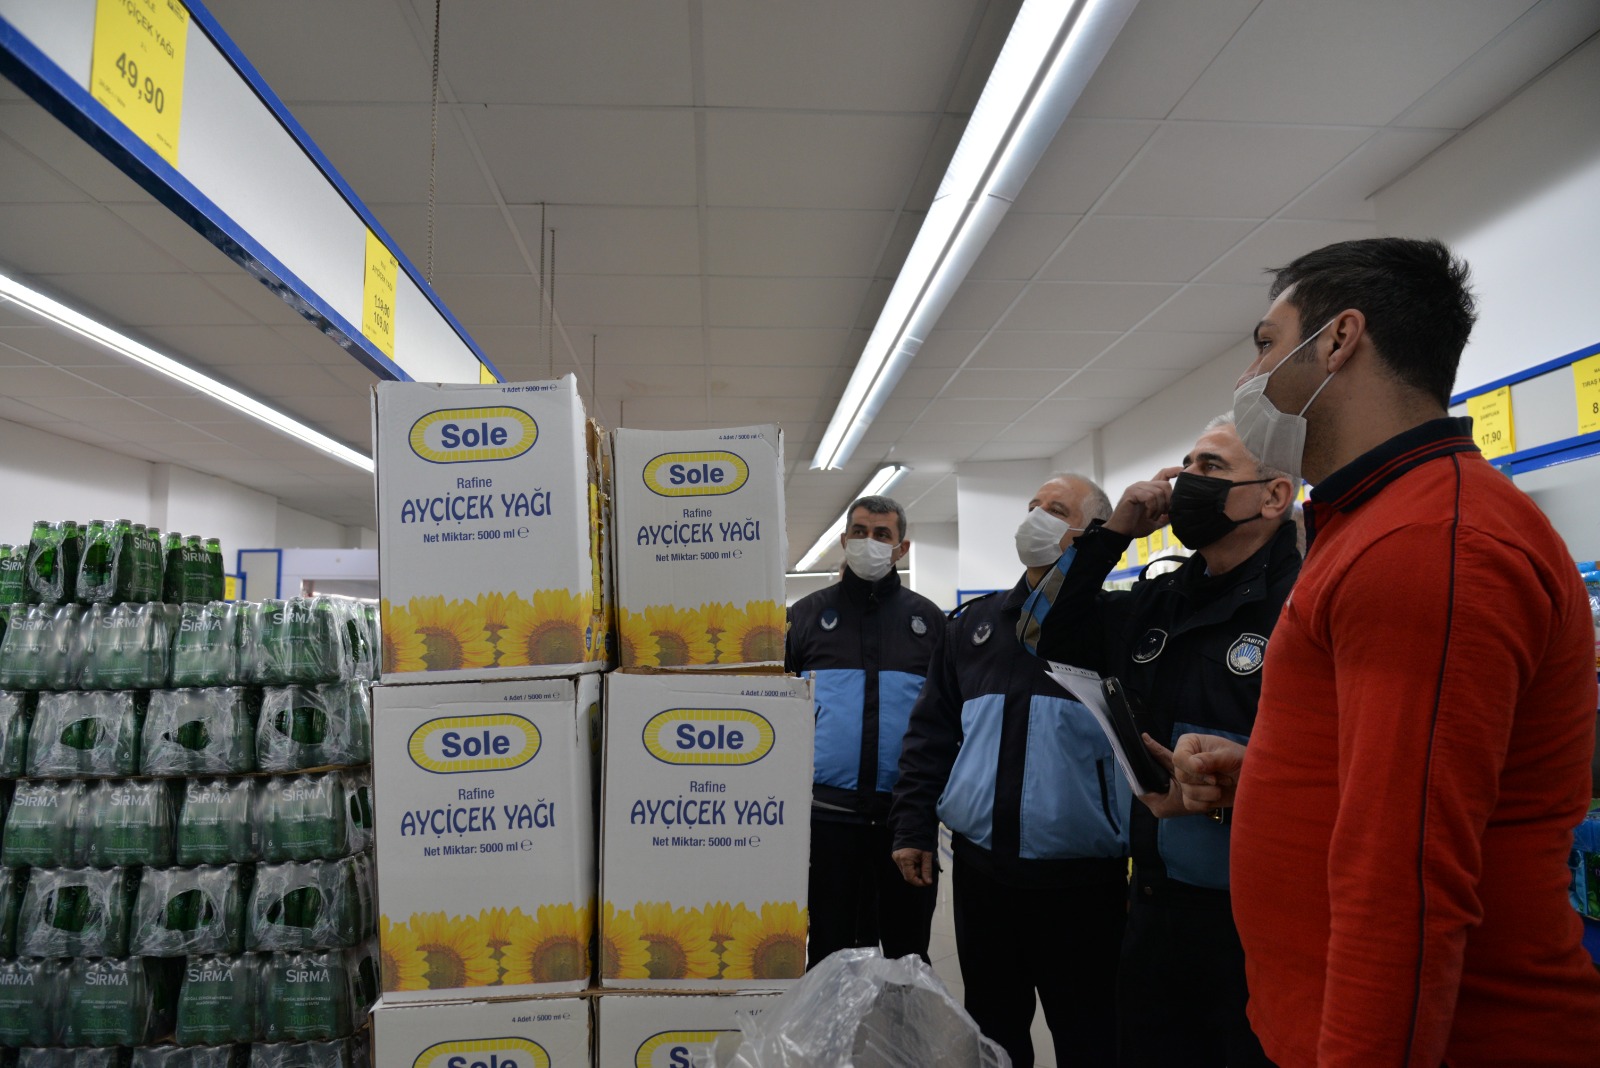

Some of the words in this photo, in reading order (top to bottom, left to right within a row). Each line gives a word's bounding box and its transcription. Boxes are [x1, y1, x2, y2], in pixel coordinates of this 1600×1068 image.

[116, 52, 164, 114] 49,90
[441, 423, 508, 448] Sole
[1482, 430, 1501, 445] 17,90
[669, 464, 724, 484] Sole
[457, 477, 492, 489] Rafine
[401, 492, 494, 526] AYÇİÇEK
[502, 487, 552, 517] YAĞI
[683, 508, 712, 518] Rafine
[424, 533, 440, 543] Net
[441, 531, 474, 542] Miktar:
[478, 530, 500, 540] 5000
[503, 529, 515, 538] ml
[637, 521, 713, 548] AYÇİÇEK
[720, 518, 760, 541] YAĞI
[134, 537, 157, 553] SIRMA
[182, 549, 211, 564] SIRMA
[656, 553, 669, 562] Net
[671, 552, 698, 561] Miktar:
[700, 552, 719, 560] 5000
[722, 551, 731, 559] ml
[1, 560, 25, 571] SIRM
[12, 618, 54, 631] SIRMA
[102, 615, 145, 629] SIRMA
[181, 619, 222, 632] SIRMA
[676, 724, 744, 749] Sole
[441, 730, 510, 758] Sole
[690, 780, 726, 793] Rafine
[14, 793, 58, 808] SIRMA
[110, 792, 151, 806] SIRMA
[187, 790, 231, 804] SIRMA
[282, 786, 326, 802] SIRMA
[458, 788, 495, 800] Rafine
[401, 804, 496, 838] AYÇİÇEK
[503, 798, 555, 830] YAĞI
[631, 795, 726, 829] AYÇİÇEK
[734, 795, 784, 825] YAĞI
[652, 837, 669, 846] Net
[672, 836, 706, 846] Miktar:
[708, 837, 731, 847] 5000
[734, 837, 746, 847] ml
[424, 846, 440, 856] Net
[443, 844, 477, 855] Miktar:
[480, 843, 503, 853] 5000
[506, 842, 518, 852] ml
[0, 973, 34, 986] IRMA
[85, 972, 128, 986] SIRMA
[188, 969, 233, 982] SIRMA
[286, 969, 330, 983] SIRMA
